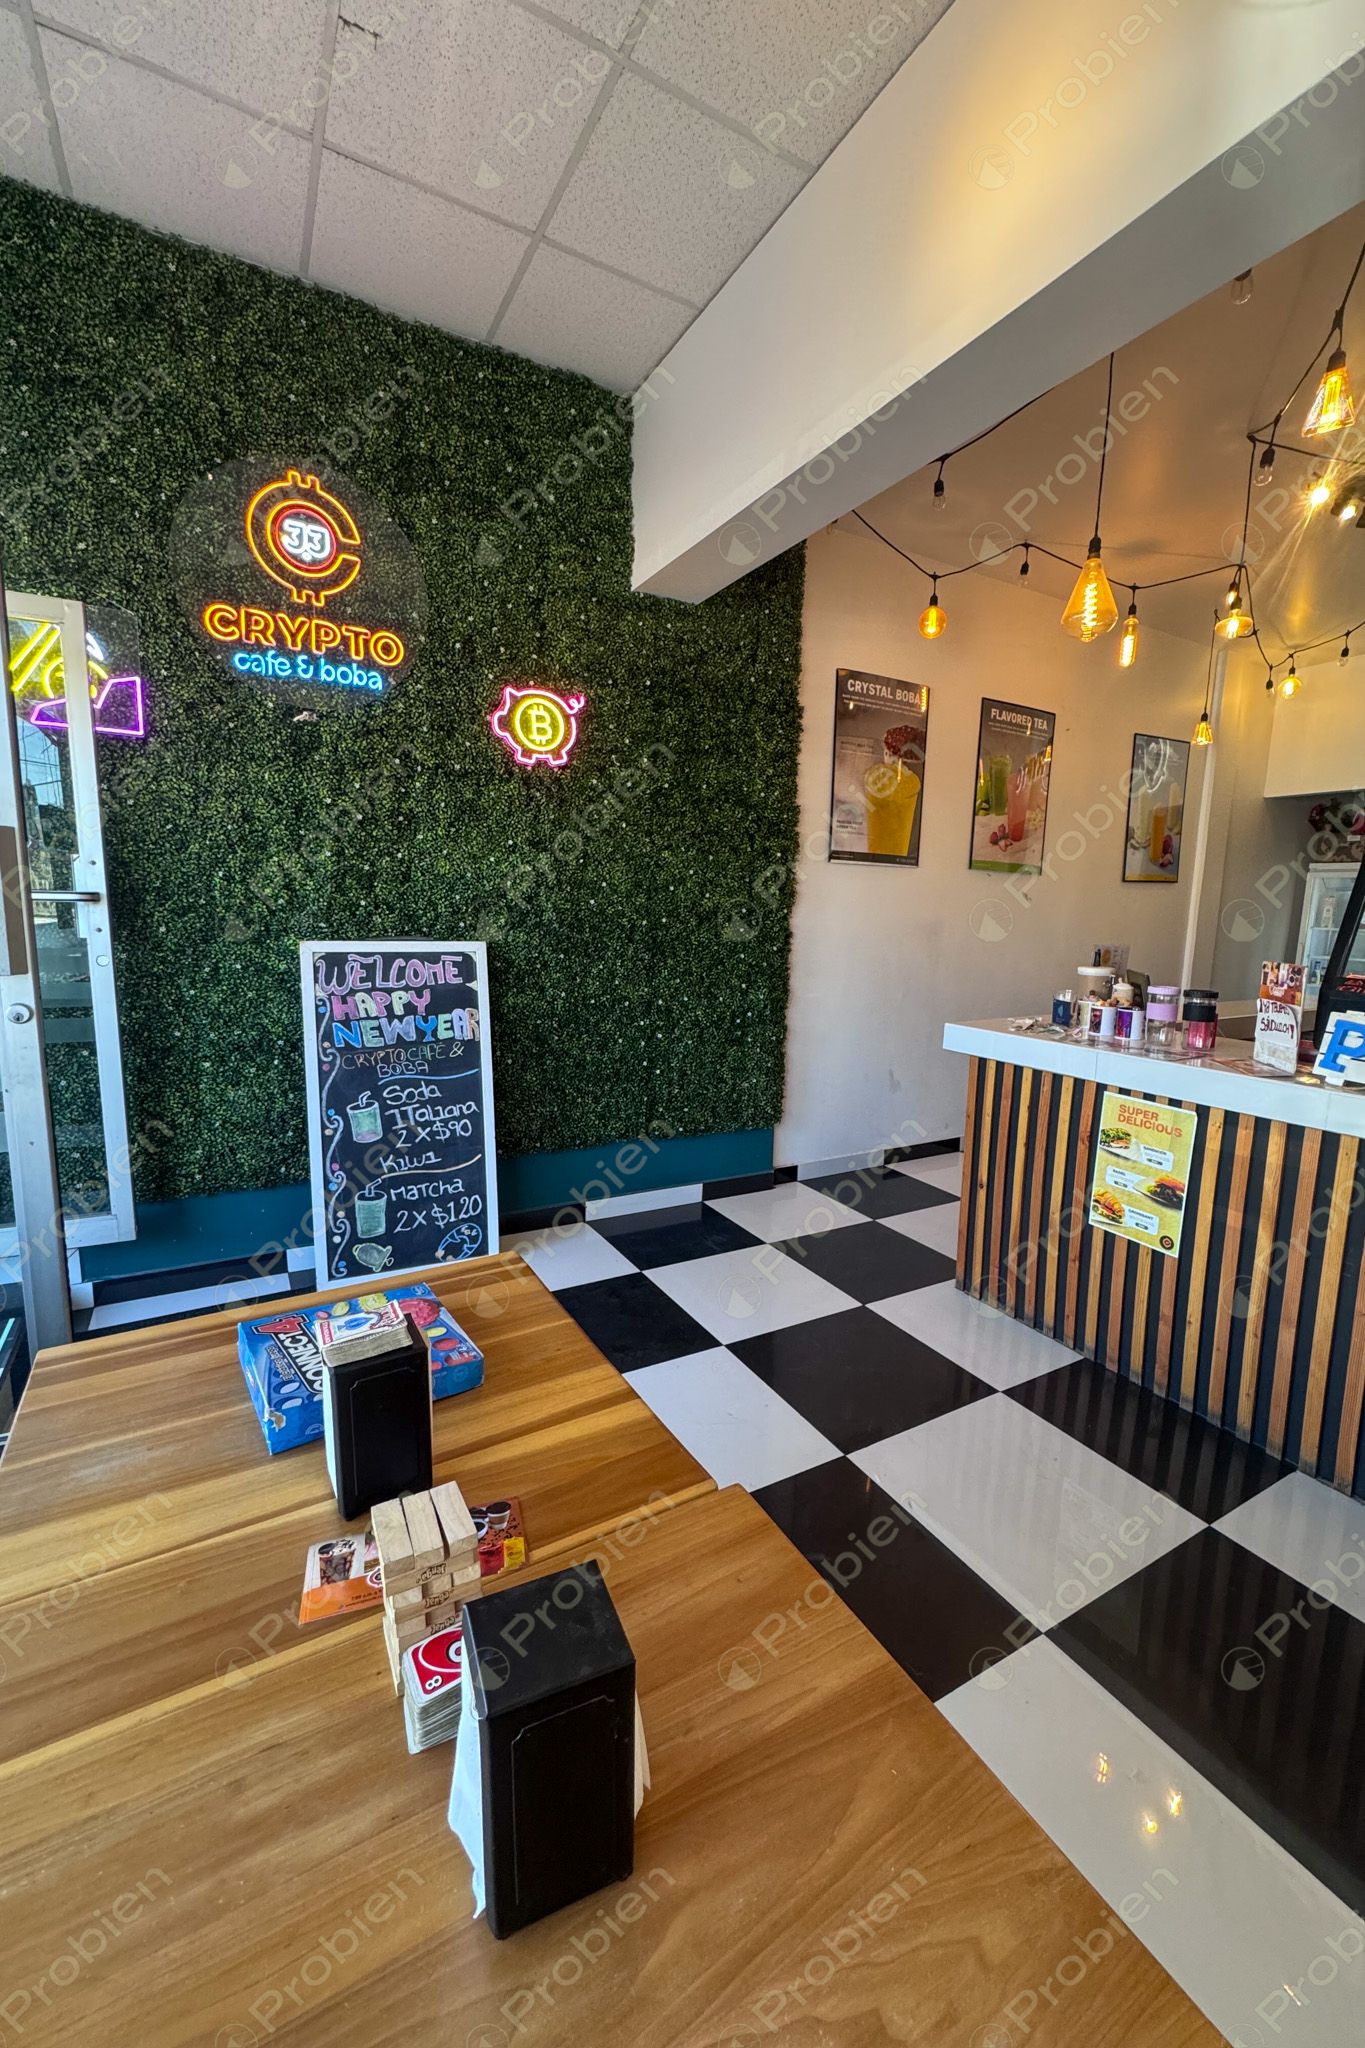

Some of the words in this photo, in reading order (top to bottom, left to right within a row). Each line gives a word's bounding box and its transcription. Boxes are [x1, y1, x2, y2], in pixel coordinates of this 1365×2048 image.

[203, 604, 405, 667] CRYPTO
[233, 649, 293, 677] cafe
[297, 655, 314, 679] &
[320, 658, 384, 691] boba
[847, 679, 893, 699] CRYSTAL
[895, 689, 921, 705] BOBA
[991, 708, 1032, 726] FLAVORED
[1034, 718, 1048, 731] TEA
[315, 954, 463, 995] WELCOME
[331, 988, 431, 1021] HAPPY
[377, 1061, 429, 1078] BOBA
[383, 1081, 442, 1105] Soda
[1117, 1113, 1183, 1138] DELICIOUS
[1119, 1104, 1160, 1122] SUPER
[433, 1118, 472, 1143] $90
[431, 1194, 482, 1230] $120
[257, 1315, 304, 1333] 4
